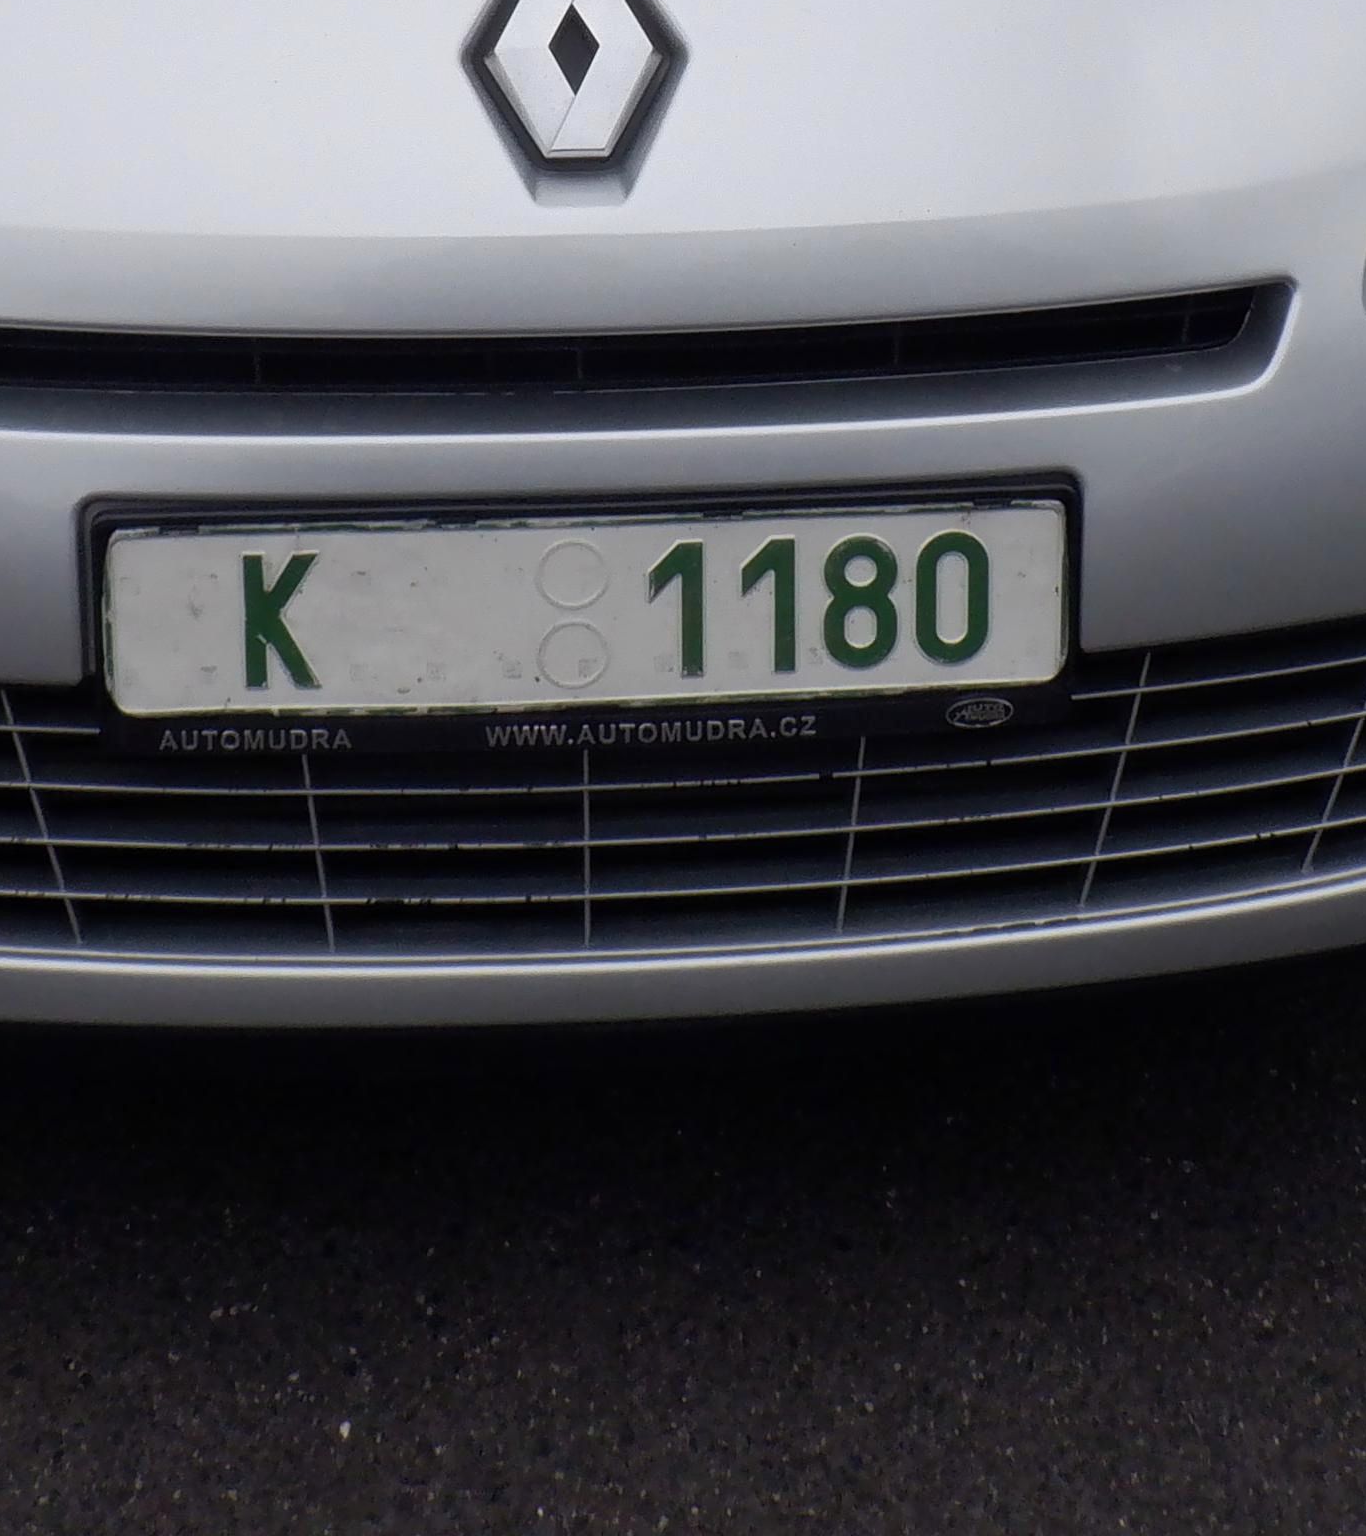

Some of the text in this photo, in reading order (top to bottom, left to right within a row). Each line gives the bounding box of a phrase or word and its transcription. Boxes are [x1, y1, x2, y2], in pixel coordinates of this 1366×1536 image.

[241, 529, 991, 690] K 1180
[158, 715, 818, 752] AUTOMUDRA WWW.AUTOMUDRA.CZ
